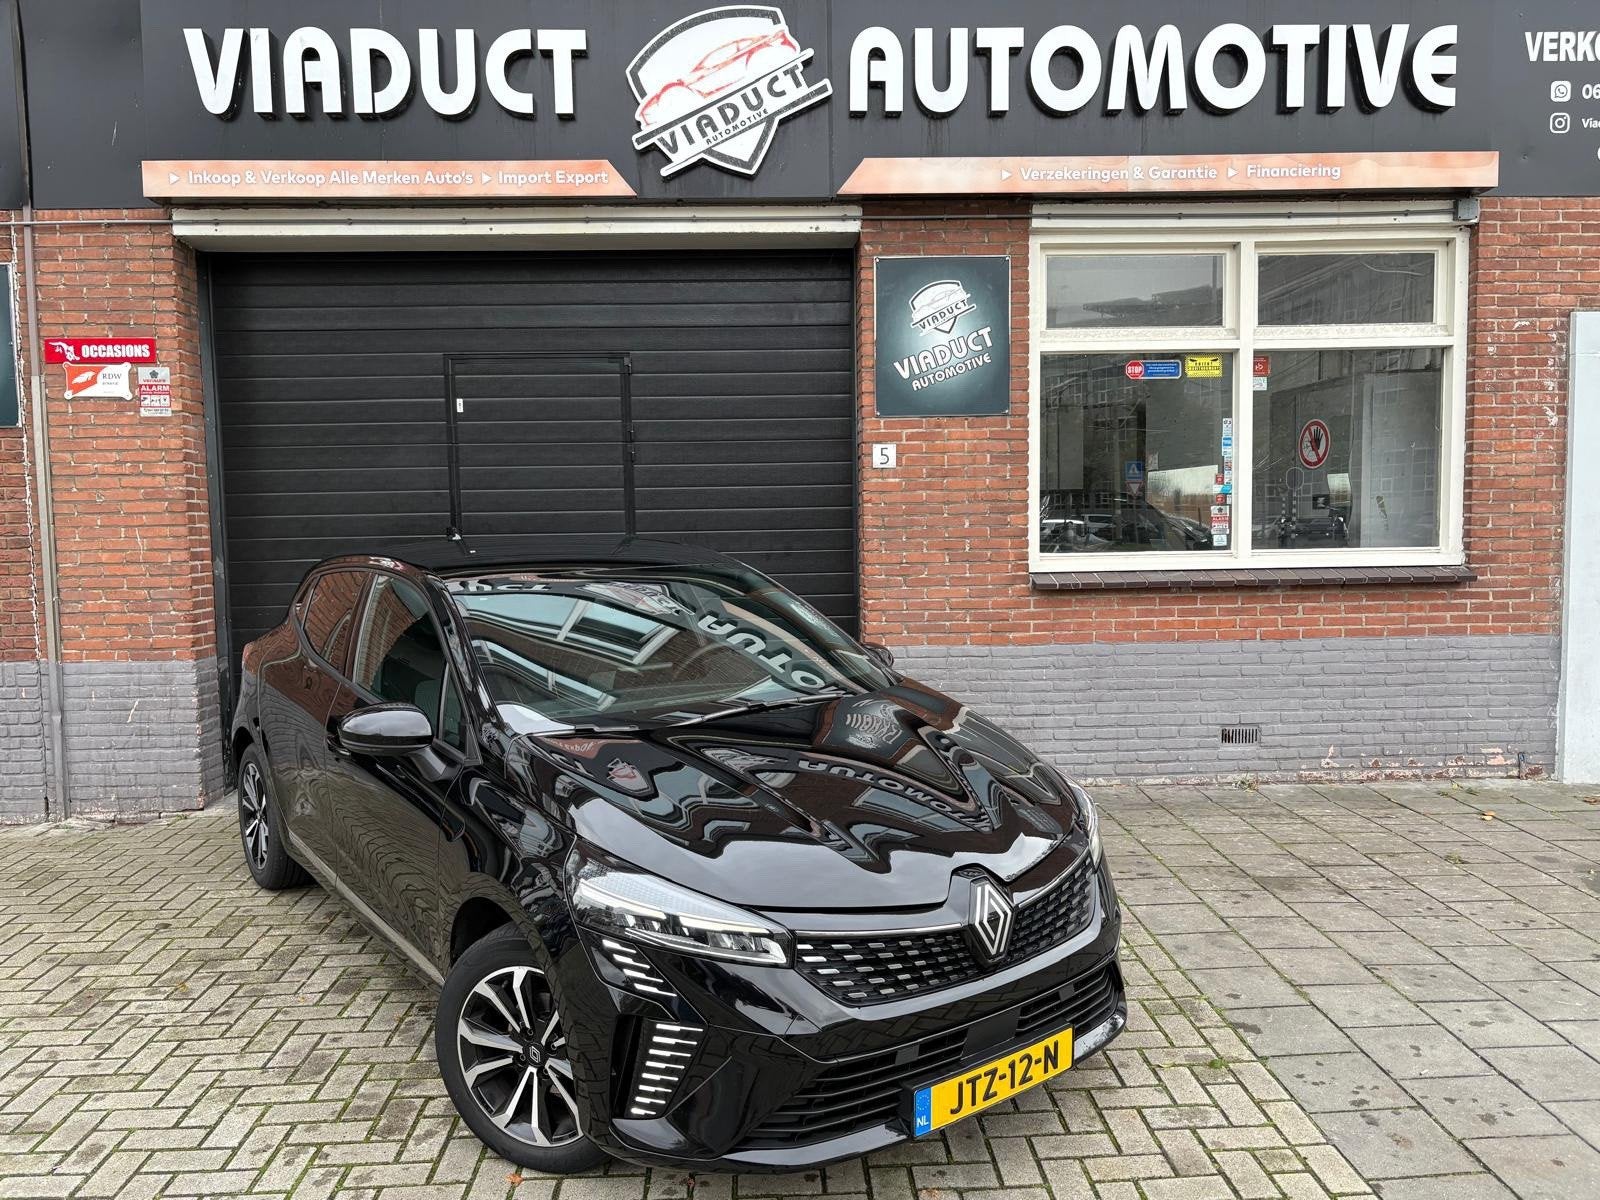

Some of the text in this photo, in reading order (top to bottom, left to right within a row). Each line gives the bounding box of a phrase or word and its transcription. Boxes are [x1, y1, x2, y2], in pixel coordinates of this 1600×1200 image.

[183, 23, 1458, 117] VIADUCT AUTOMOTIVE
[657, 64, 805, 154] VIADUCT
[706, 108, 769, 145] AUTOMOTIVE
[1582, 117, 1600, 129] Via
[189, 170, 608, 187] Inkoop & Verkoop Alle Merken Auto's Import Export
[1020, 164, 1342, 183] Verzekeringen & Garantie Financiering
[919, 299, 968, 331] VIADUCT
[81, 344, 151, 358] OCCASIONS
[893, 327, 993, 380] VIADUCT
[102, 372, 122, 380] RDW
[912, 352, 992, 391] AUTOMOTIVE
[1127, 366, 1143, 374] STOP
[879, 447, 890, 465] 5
[950, 1040, 1059, 1115] JTZ-12-N
[916, 1115, 929, 1128] NL
